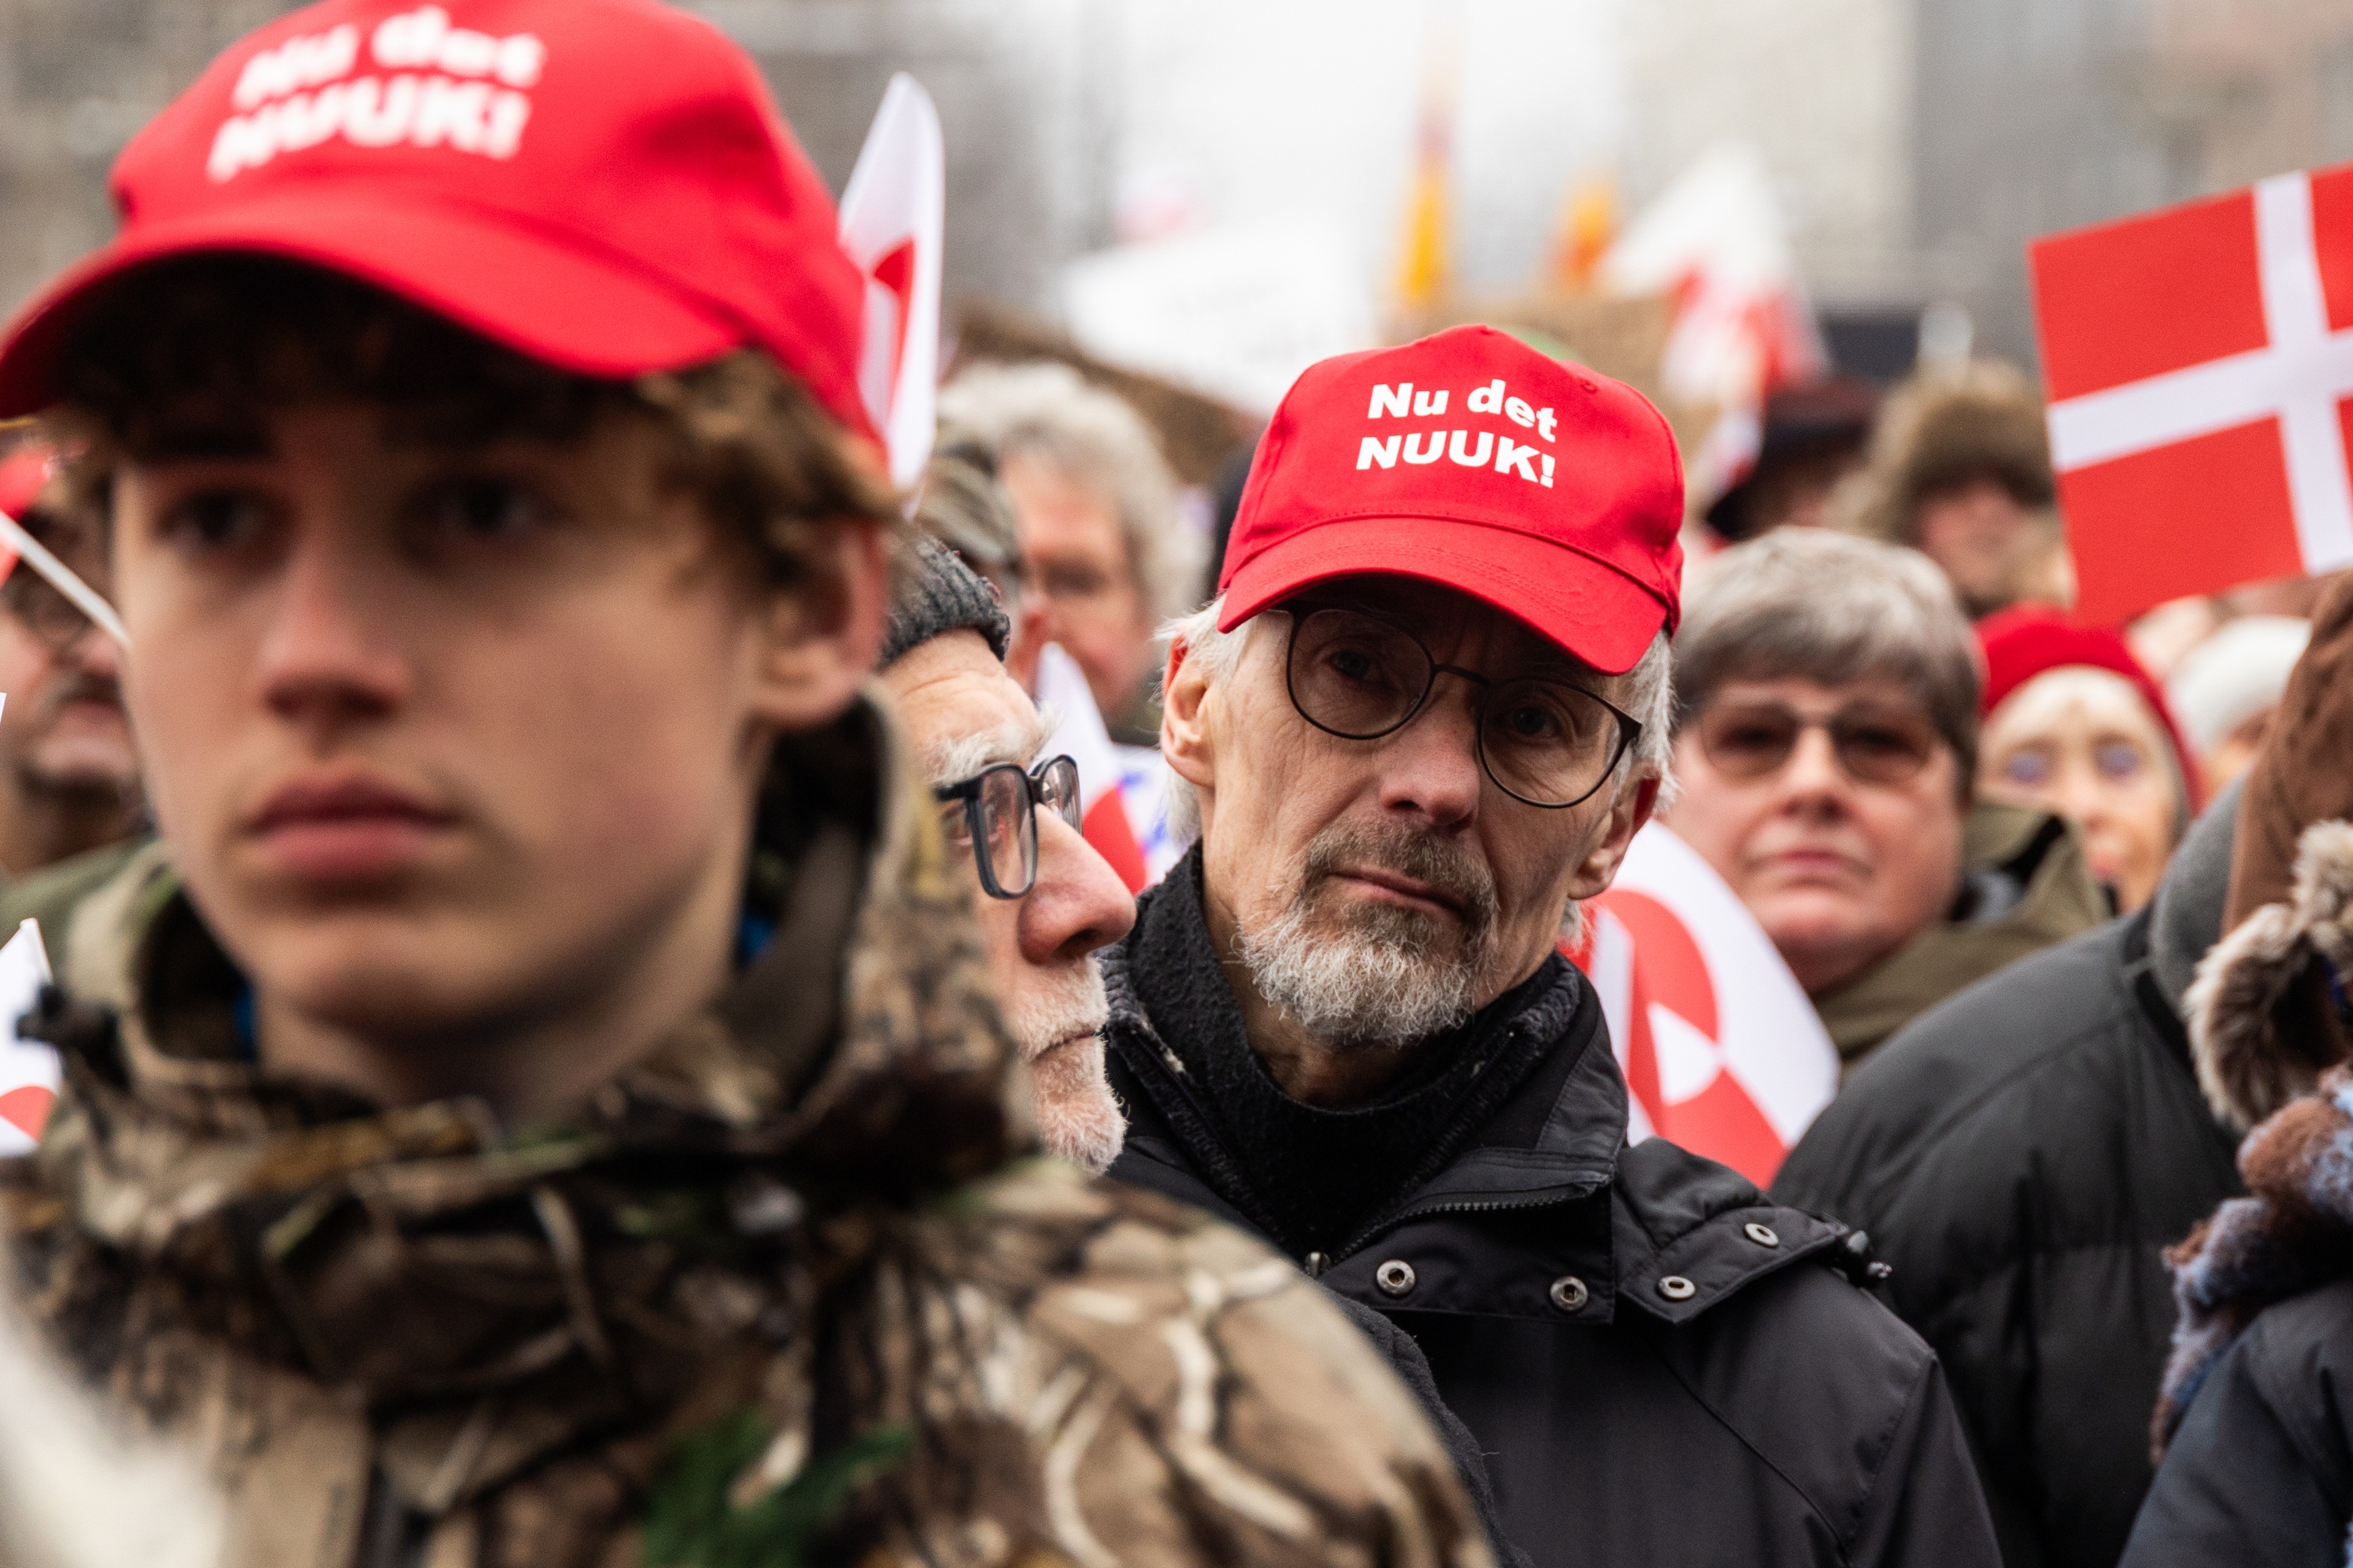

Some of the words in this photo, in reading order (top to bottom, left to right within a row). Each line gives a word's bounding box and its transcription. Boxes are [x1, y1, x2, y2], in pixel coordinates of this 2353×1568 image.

[234, 24, 359, 110] Nu
[372, 5, 546, 87] det
[206, 75, 531, 182] NUUK!
[1368, 383, 1449, 419] Nu
[1467, 378, 1558, 443] det
[1356, 430, 1555, 488] NUUK!
